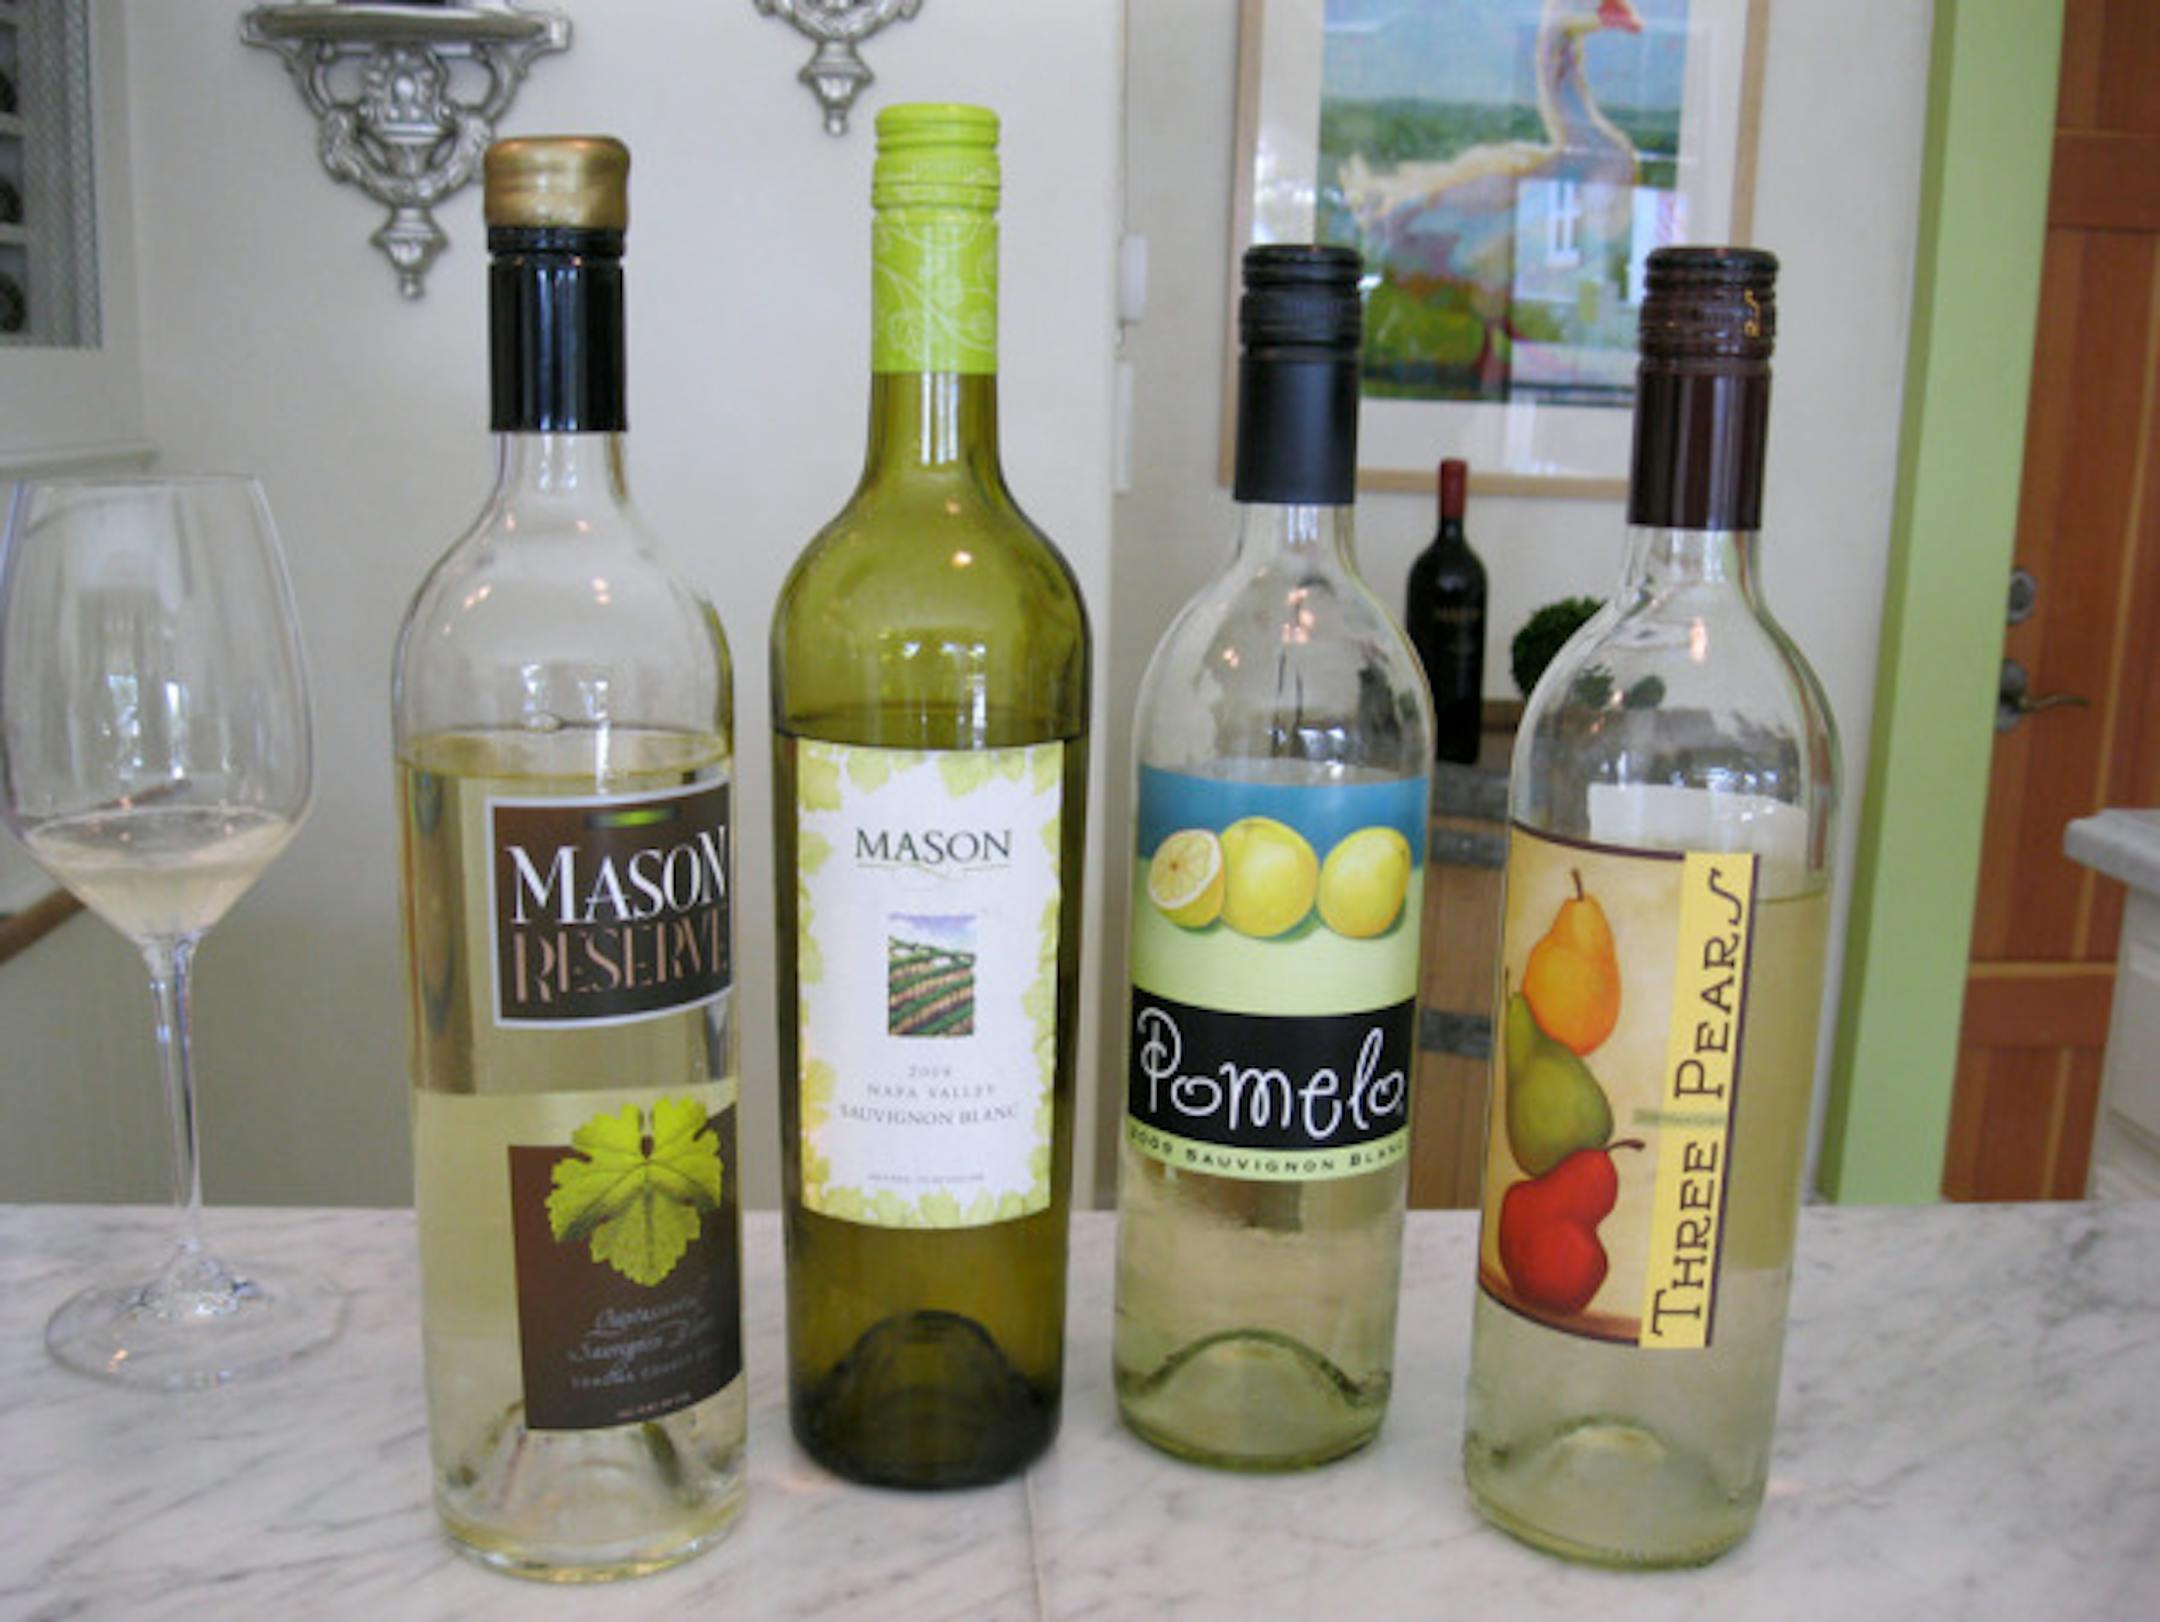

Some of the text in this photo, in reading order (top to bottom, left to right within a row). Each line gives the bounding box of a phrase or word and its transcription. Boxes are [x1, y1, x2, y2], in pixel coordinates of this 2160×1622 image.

[507, 826, 726, 924] MASON
[855, 827, 1012, 865] MASON
[1673, 867, 1742, 1099] PEARS
[839, 1103, 953, 1126] SAUVIGNON
[1136, 1006, 1405, 1140] Pomelo
[1185, 1148, 1335, 1173] SAUVIGNON
[1651, 1141, 1718, 1336] THREE
